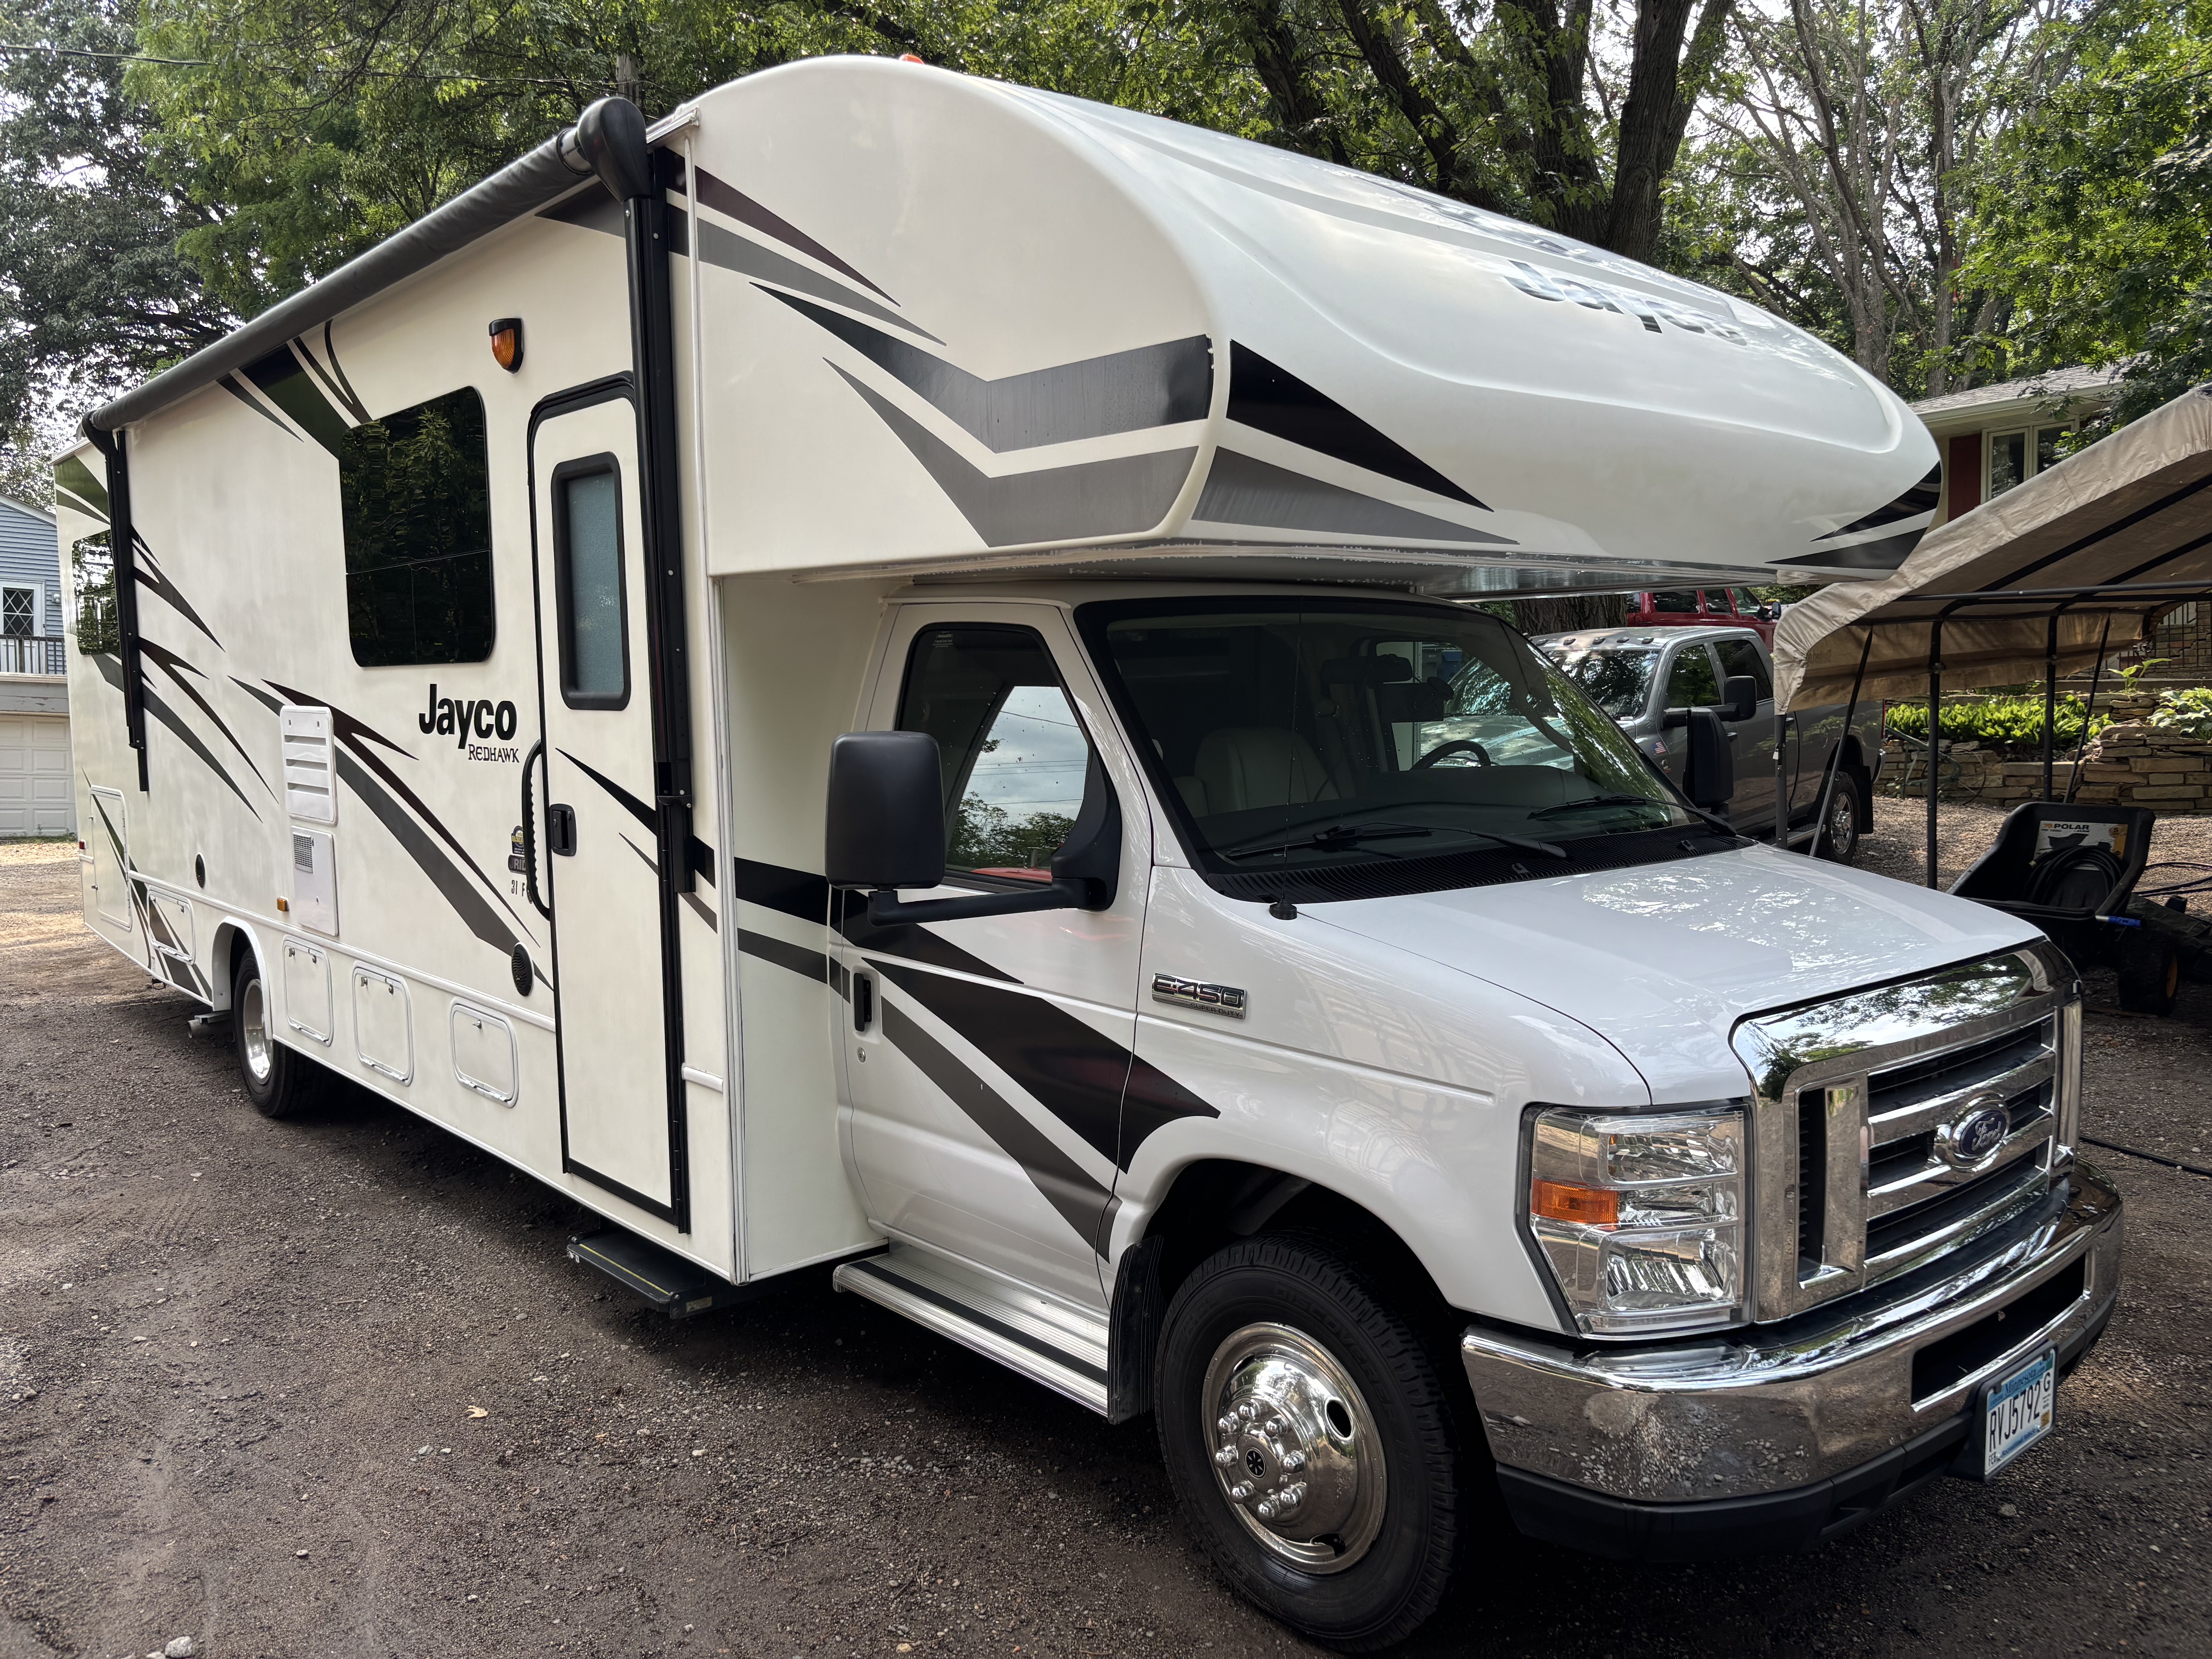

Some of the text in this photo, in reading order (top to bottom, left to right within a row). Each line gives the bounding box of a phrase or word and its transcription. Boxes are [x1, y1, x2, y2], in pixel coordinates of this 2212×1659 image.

[1503, 259, 1747, 346] Jayco
[419, 684, 517, 749] Jayco
[468, 744, 519, 763] REDHAWK
[511, 880, 517, 895] 31
[1191, 1003, 1240, 1017] SUPER DUTY
[1972, 1117, 2001, 1151] Ford
[1989, 1380, 2040, 1452] RVJ5792
[2044, 1372, 2051, 1392] G
